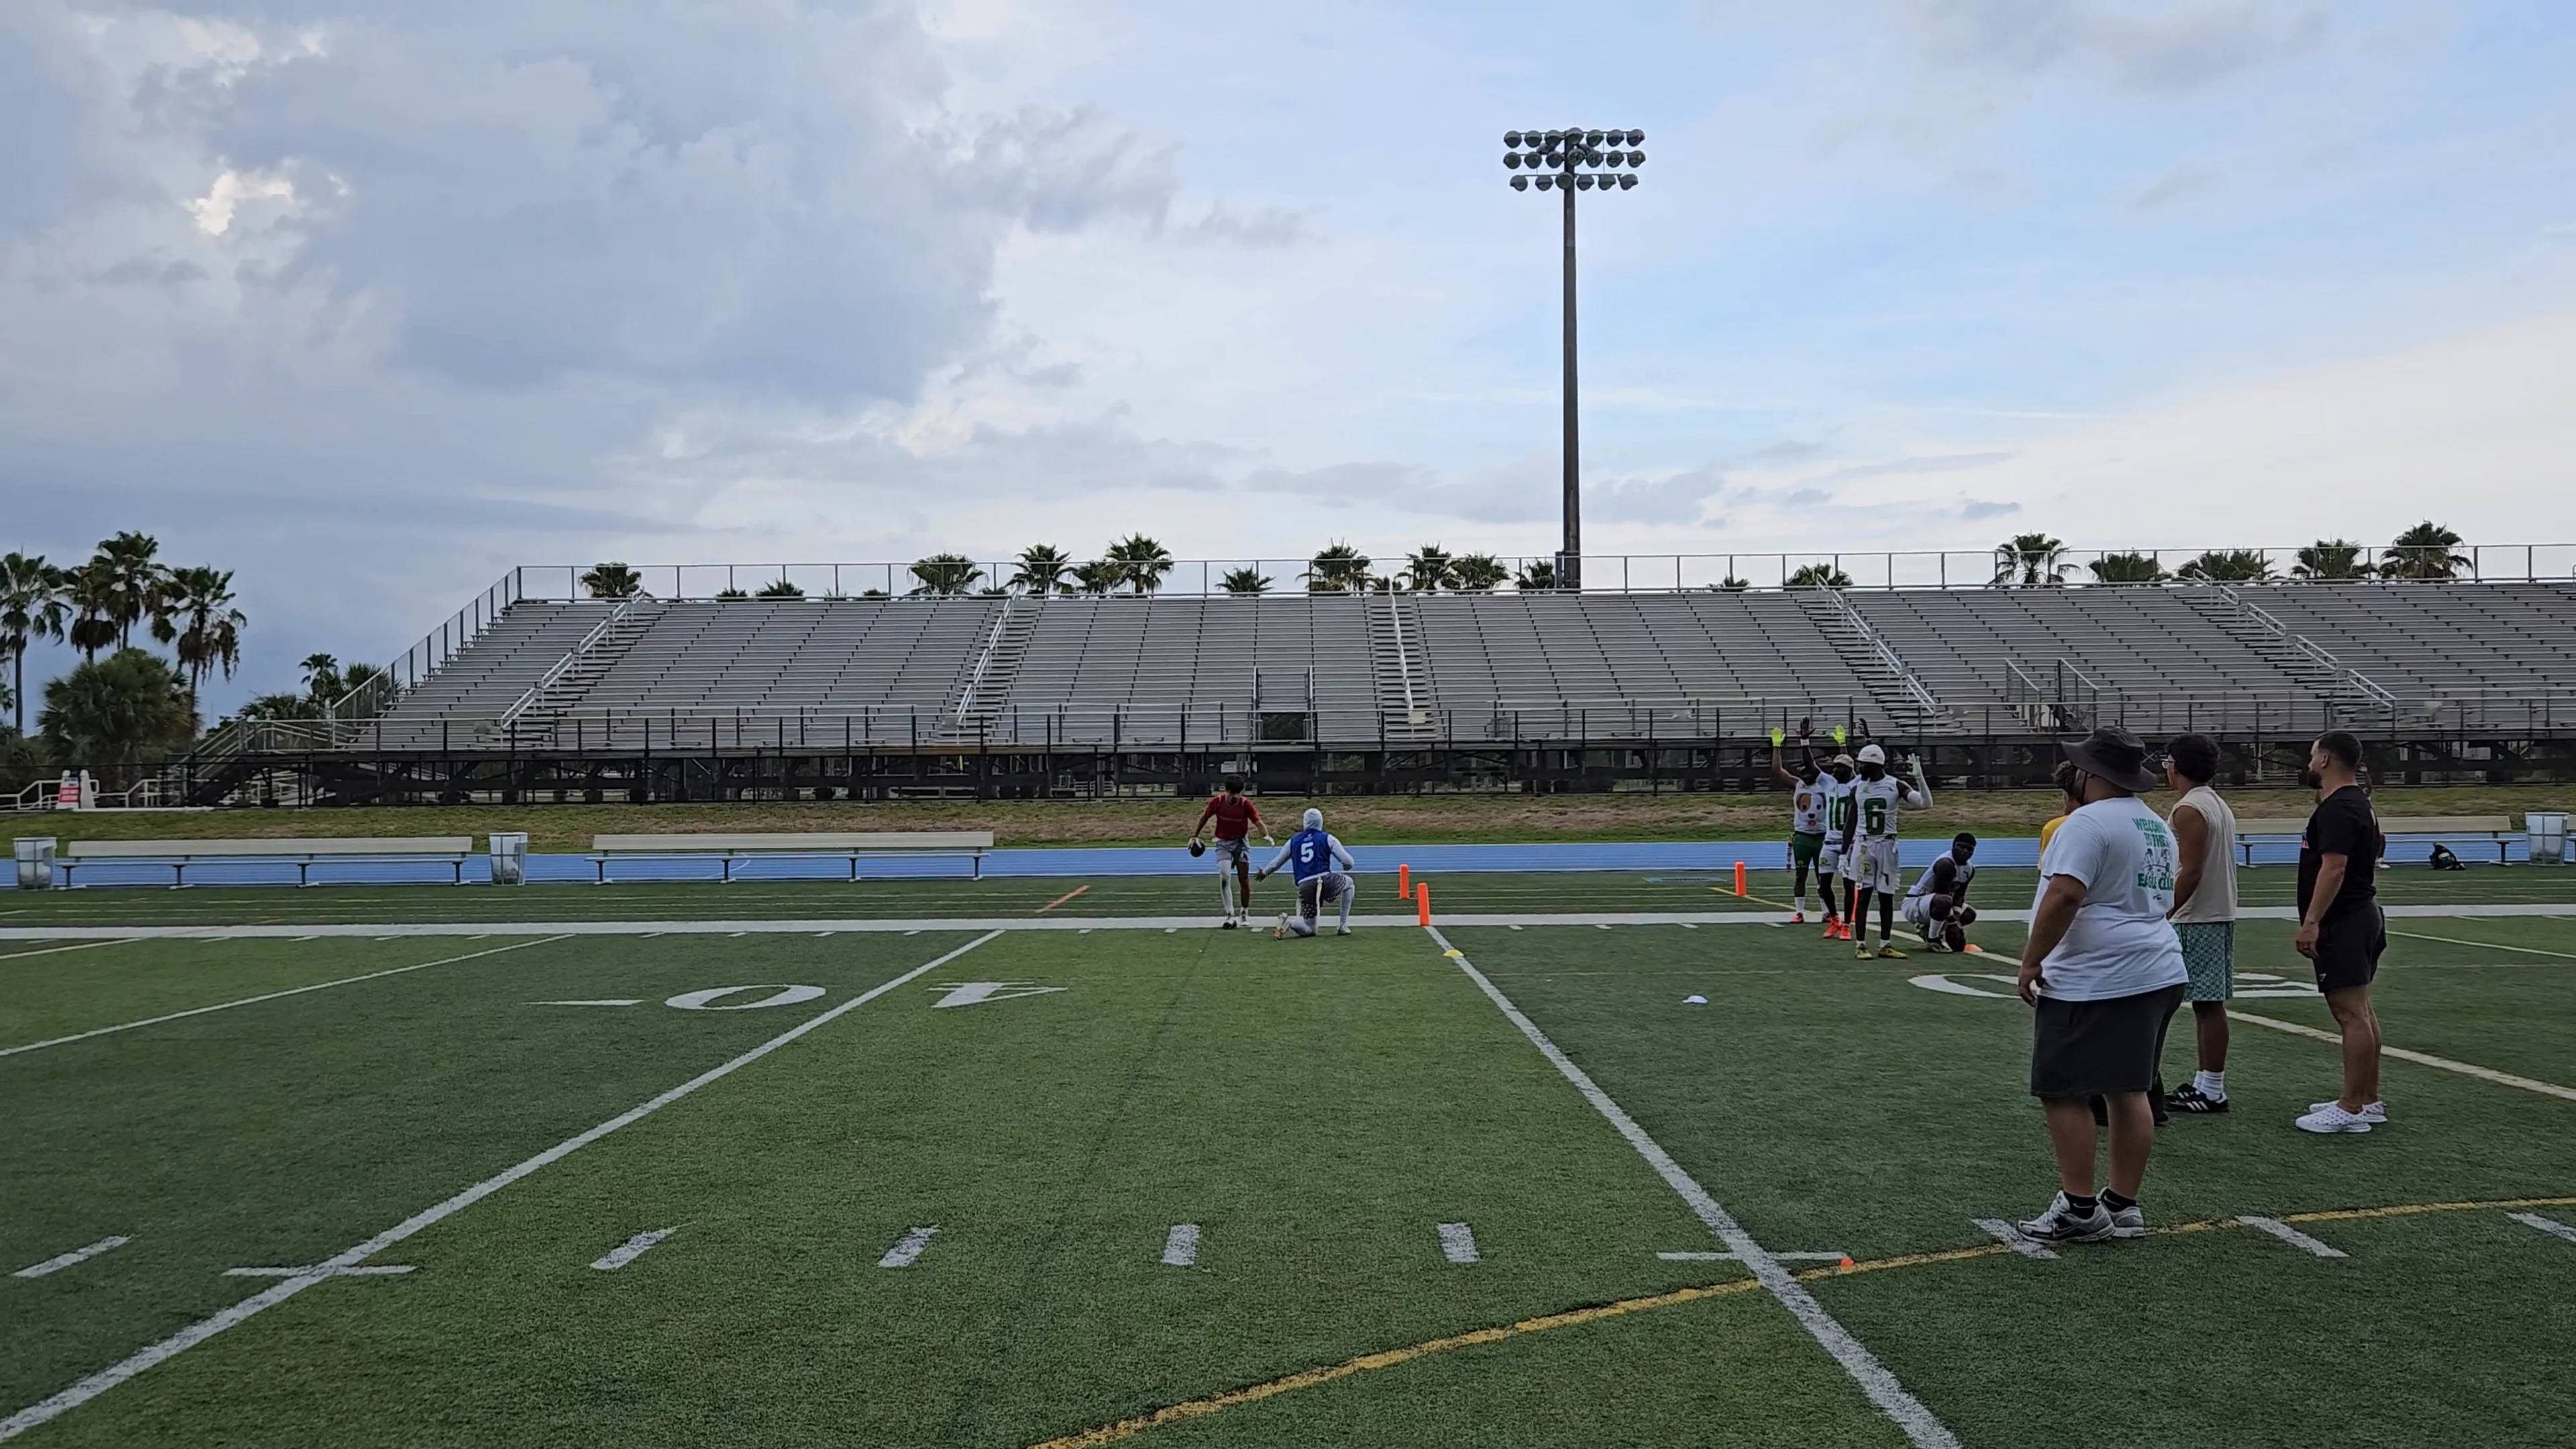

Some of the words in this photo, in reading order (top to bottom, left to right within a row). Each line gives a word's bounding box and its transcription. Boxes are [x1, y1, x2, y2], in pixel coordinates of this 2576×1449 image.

[1829, 796, 1849, 831] 10
[1864, 797, 1886, 835] 6
[1301, 841, 1314, 863] 5
[2151, 833, 2165, 847] THE
